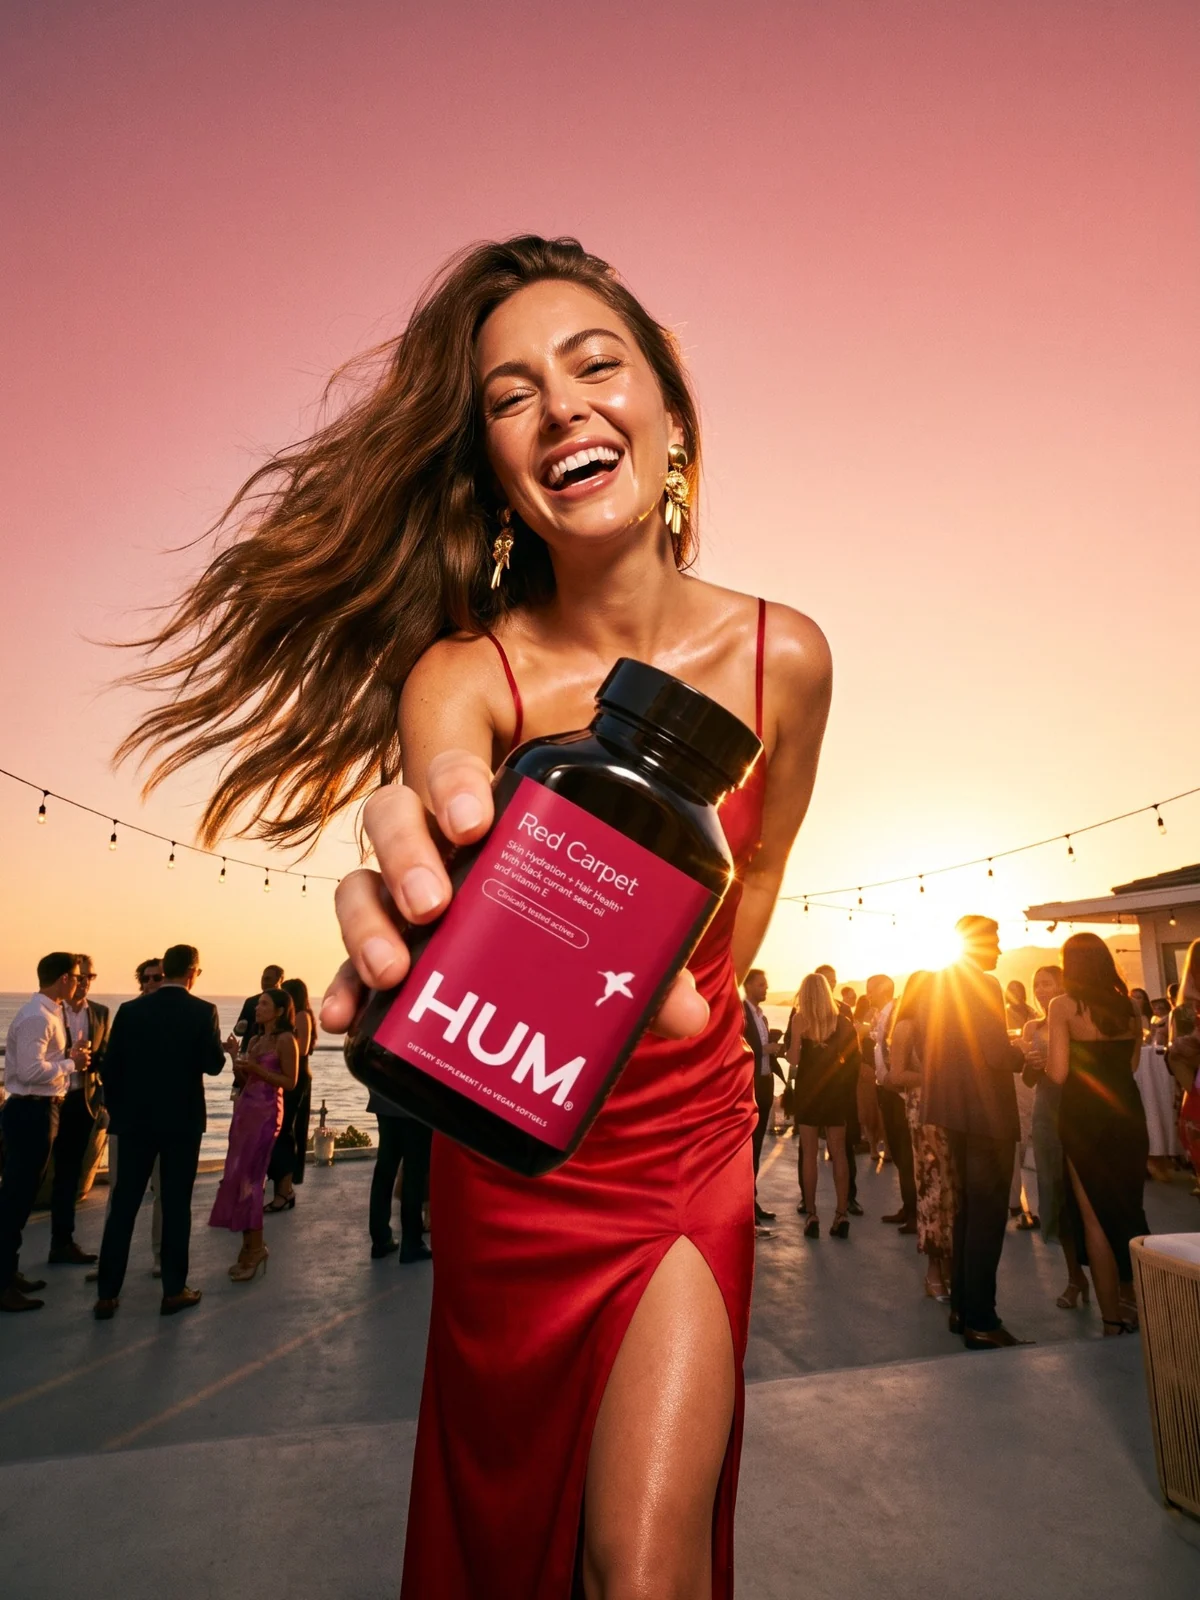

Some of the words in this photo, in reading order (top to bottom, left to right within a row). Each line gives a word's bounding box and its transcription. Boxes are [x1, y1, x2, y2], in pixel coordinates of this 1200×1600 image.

[493, 862, 512, 876] and
[510, 871, 541, 893] vitamin
[541, 887, 550, 898] E
[501, 850, 520, 867] With
[519, 861, 543, 880] black
[542, 876, 573, 898] currant
[572, 894, 595, 910] seed
[593, 907, 606, 917] oil
[506, 839, 525, 856] Skin
[524, 849, 567, 879] Hydration
[574, 879, 593, 895] Hair
[517, 811, 566, 851] Red
[566, 841, 639, 896] Carpet
[496, 888, 528, 912] Clinically
[527, 907, 551, 924] tested
[550, 921, 575, 939] actives
[407, 1041, 436, 1061] DIETARY
[435, 1058, 479, 1086] SUPPLEMENT
[482, 1086, 493, 1095] 60
[492, 1091, 516, 1109] VEGAN
[515, 1105, 548, 1127] SOFTGELS
